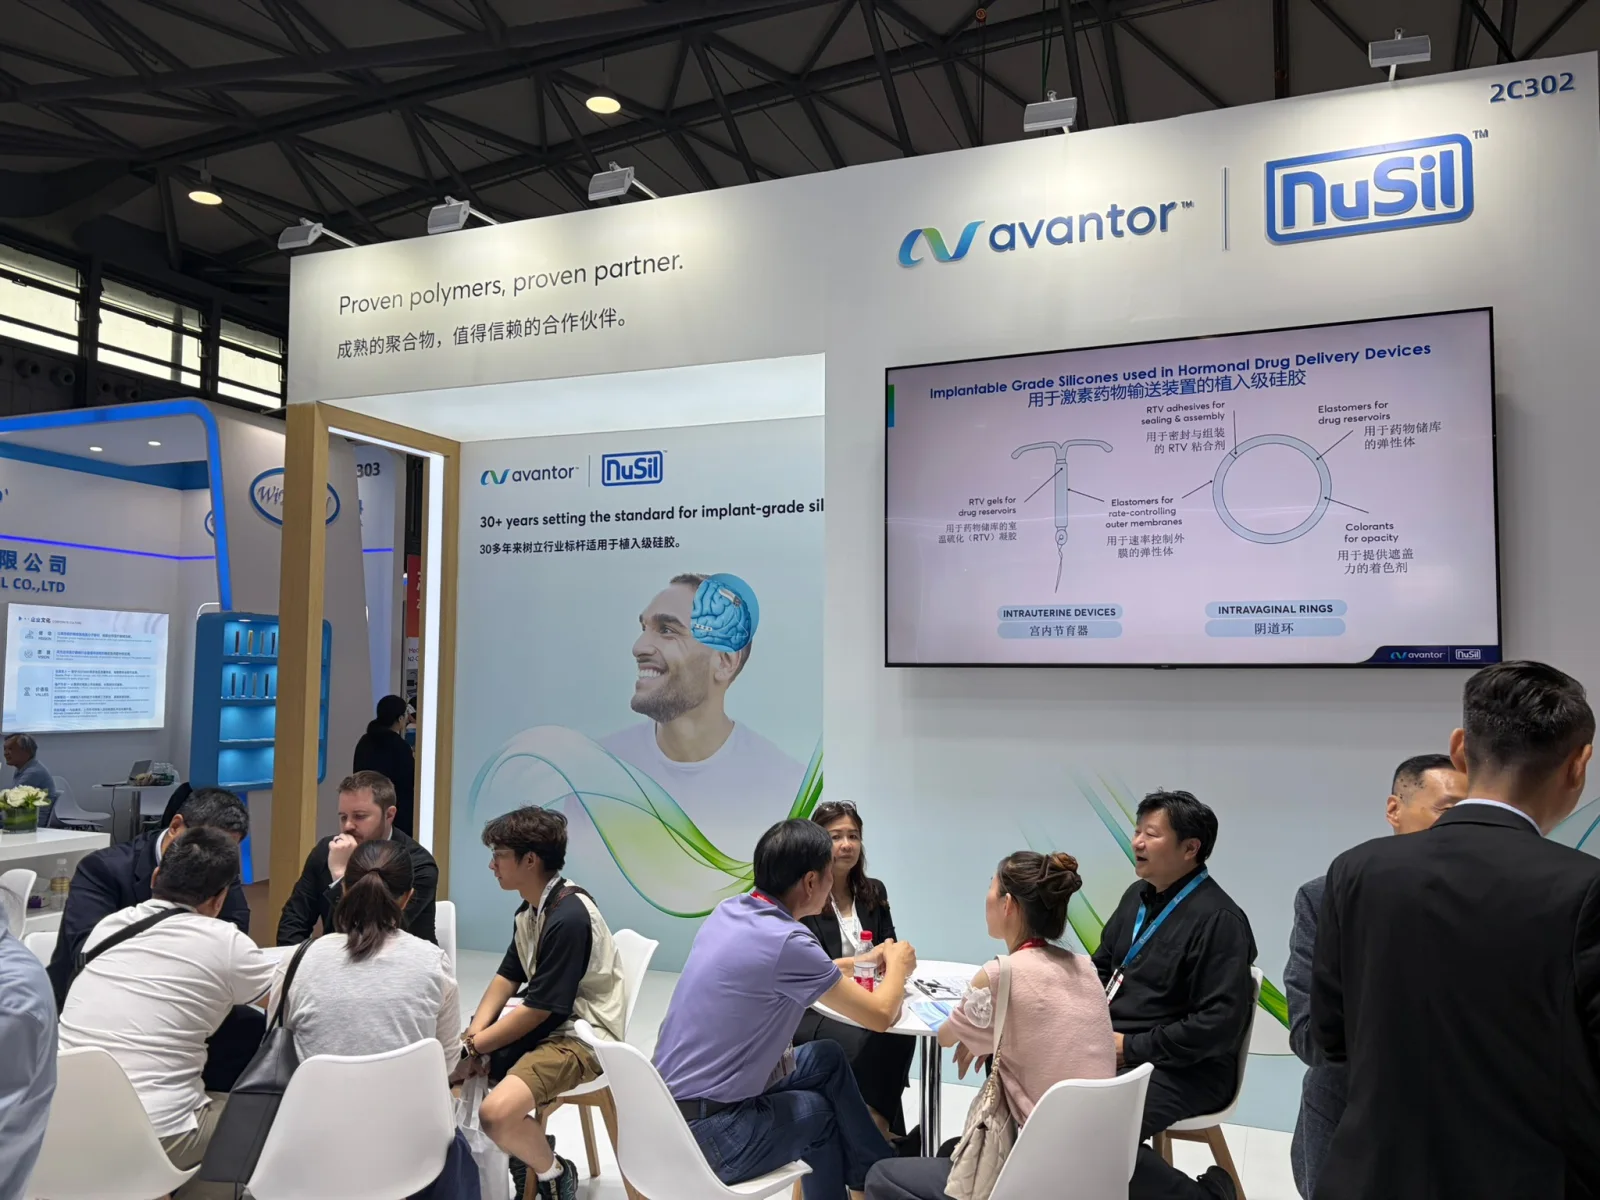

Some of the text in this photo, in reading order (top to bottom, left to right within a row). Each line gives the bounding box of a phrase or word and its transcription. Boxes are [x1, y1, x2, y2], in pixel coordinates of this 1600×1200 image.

[1490, 72, 1576, 103] 2C302
[339, 253, 684, 315] Proven polymers, proven partner.
[930, 344, 1432, 400] Implantable Grade Silicones used in Hormonal Drug Delivery Devices
[1027, 369, 1307, 408] 用于激素药物输送装置的植入级硅胶
[1146, 400, 1225, 414] RTV adhesives for
[1318, 400, 1389, 413] Elastomers for
[1141, 412, 1225, 425] sealing & assembly
[1318, 412, 1391, 425] drug reservoirs
[1146, 427, 1226, 443] 用于密封与组装
[1363, 420, 1442, 437] 用于药物储库
[1364, 436, 1416, 450] 的弹性体
[968, 496, 1017, 507] RTV gels for
[1111, 496, 1174, 507] Elastomers for
[480, 497, 824, 530] 30+ years setting the standard for implant-grade sil
[958, 507, 1017, 518] drug reservoirs
[1108, 507, 1177, 517] rate-controlling
[1105, 518, 1183, 528] outer membranes
[1345, 522, 1394, 531] Colorants
[1106, 533, 1185, 546] 用于速率控制外
[1344, 533, 1399, 544] for opacity
[1117, 546, 1174, 558] 膜的弹性体
[1337, 548, 1414, 561] 用于提供遮盖
[1344, 561, 1408, 575] 力的着色剂
[1003, 608, 1116, 618] INTRAUTERINE DEVICES
[1218, 604, 1334, 615] INTRAVAGINAL RINGS
[1029, 625, 1089, 637] 宫内节育器
[1254, 622, 1295, 635] 阴道环
